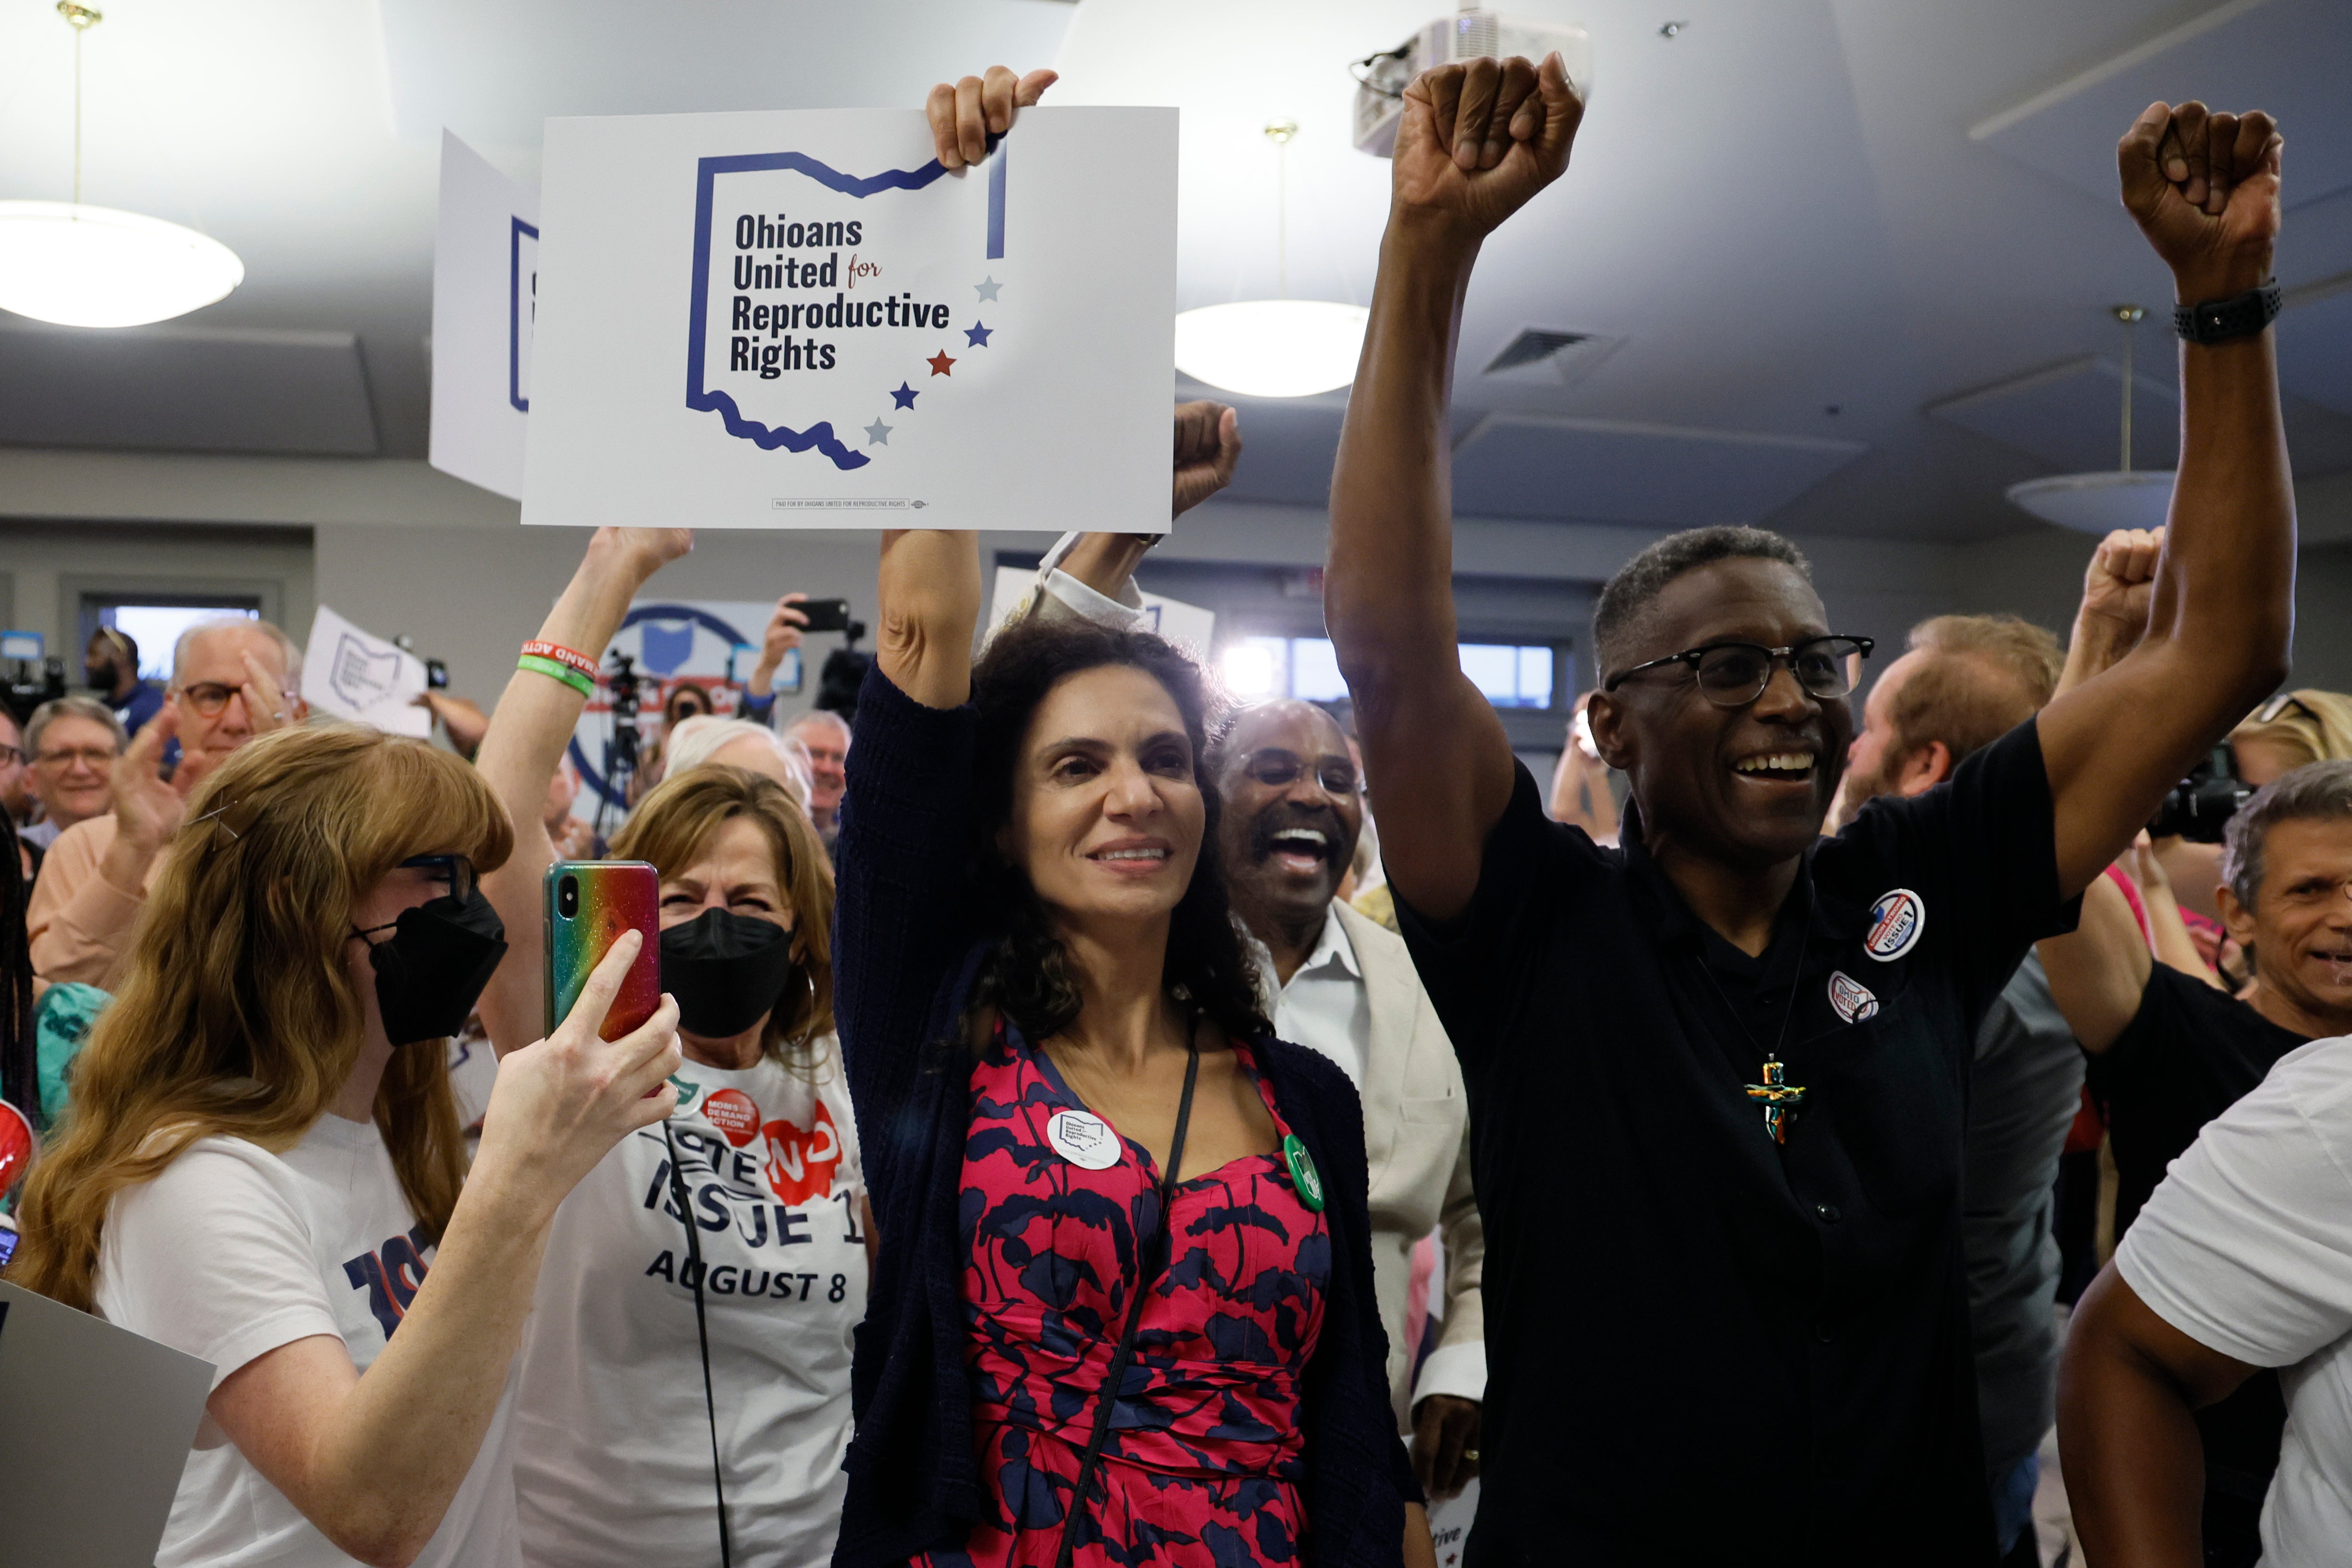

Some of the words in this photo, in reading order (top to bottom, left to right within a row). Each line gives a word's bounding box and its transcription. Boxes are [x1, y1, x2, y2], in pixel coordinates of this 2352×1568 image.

[736, 214, 862, 250] Ohioans
[734, 252, 837, 290] United
[848, 253, 882, 289] for
[732, 293, 949, 338] Reproductive
[731, 335, 835, 379] Rights
[1870, 923, 1887, 946] UNION
[1885, 896, 1906, 924] STRONG
[1883, 924, 1896, 940] VOTE
[1884, 918, 1909, 949] ISSUE
[1836, 990, 1857, 1011] VOTED
[1839, 985, 1859, 1003] OHIO
[707, 1108, 751, 1121] DEMAND
[707, 1116, 745, 1128] ACTION
[708, 1100, 739, 1111] MOMS
[1065, 1129, 1097, 1141] Reproductive
[768, 1121, 839, 1184] NO
[833, 1189, 865, 1243] 1
[645, 1250, 818, 1301] AUGUST
[828, 1273, 846, 1303] 8
